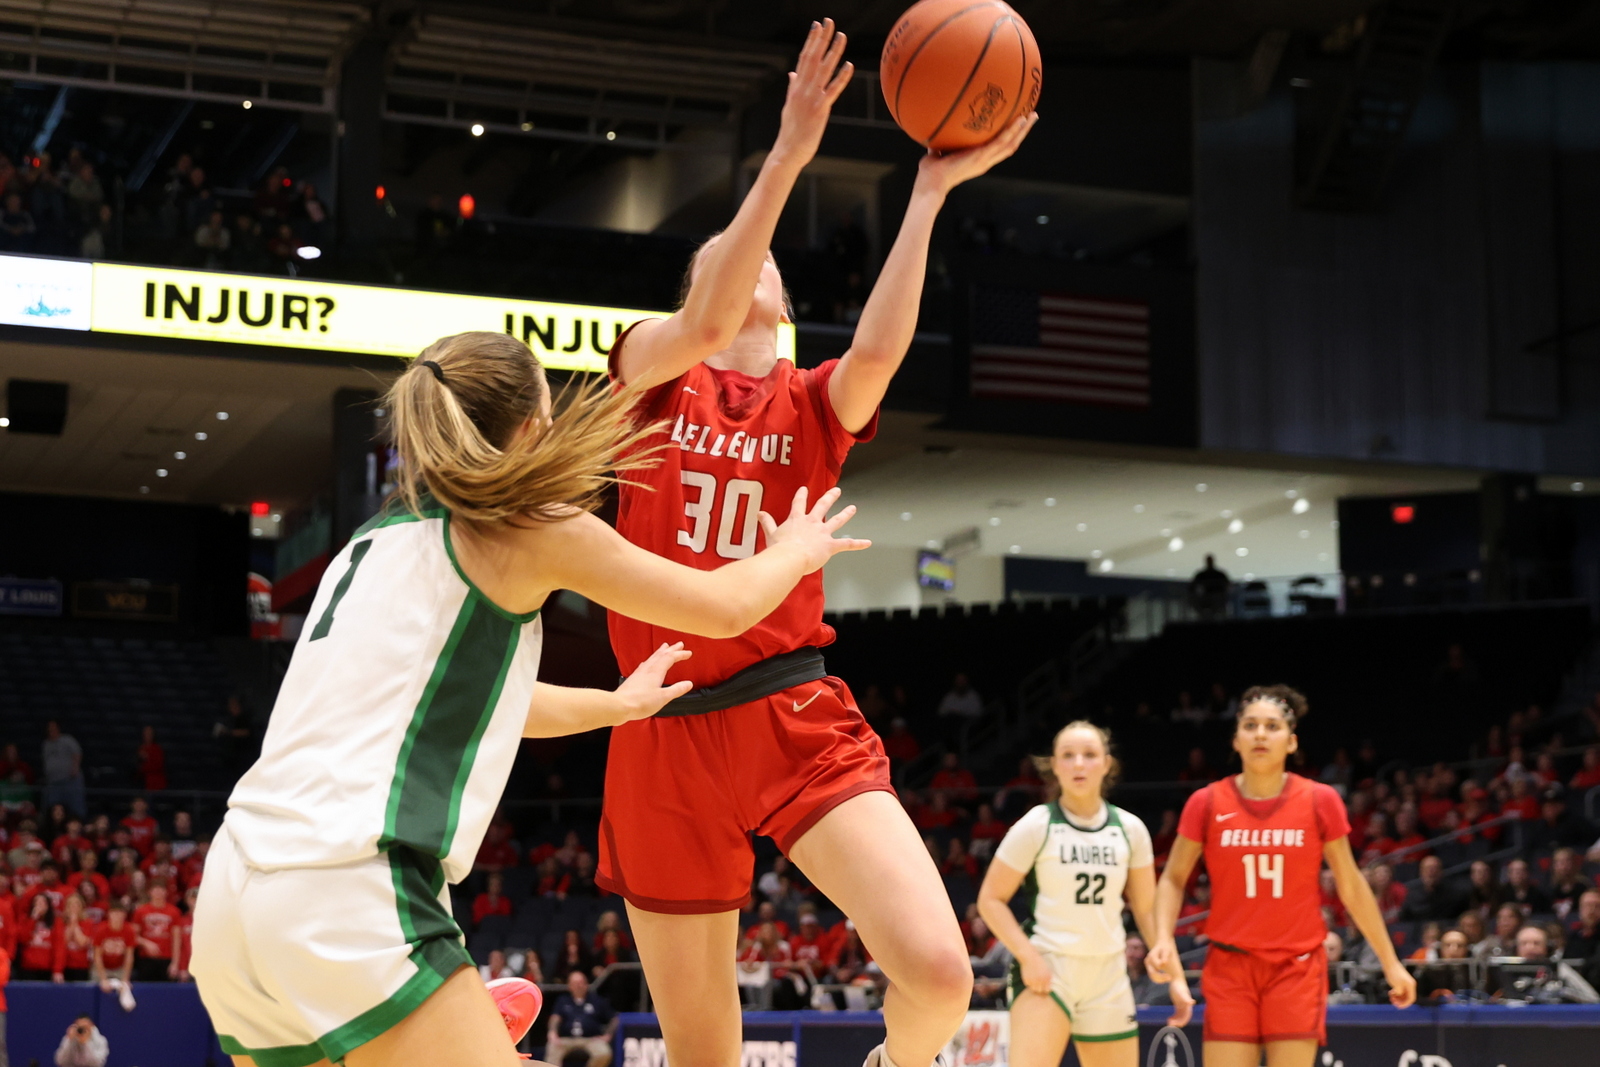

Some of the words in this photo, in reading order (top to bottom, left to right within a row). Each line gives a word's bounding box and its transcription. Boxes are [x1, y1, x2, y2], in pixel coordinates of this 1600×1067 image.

[677, 470, 764, 560] 30
[309, 538, 373, 642] 1
[1060, 845, 1118, 865] LAUREL
[1220, 829, 1305, 847] BELLEVUE
[1076, 873, 1106, 904] 22
[1242, 853, 1284, 898] 14
